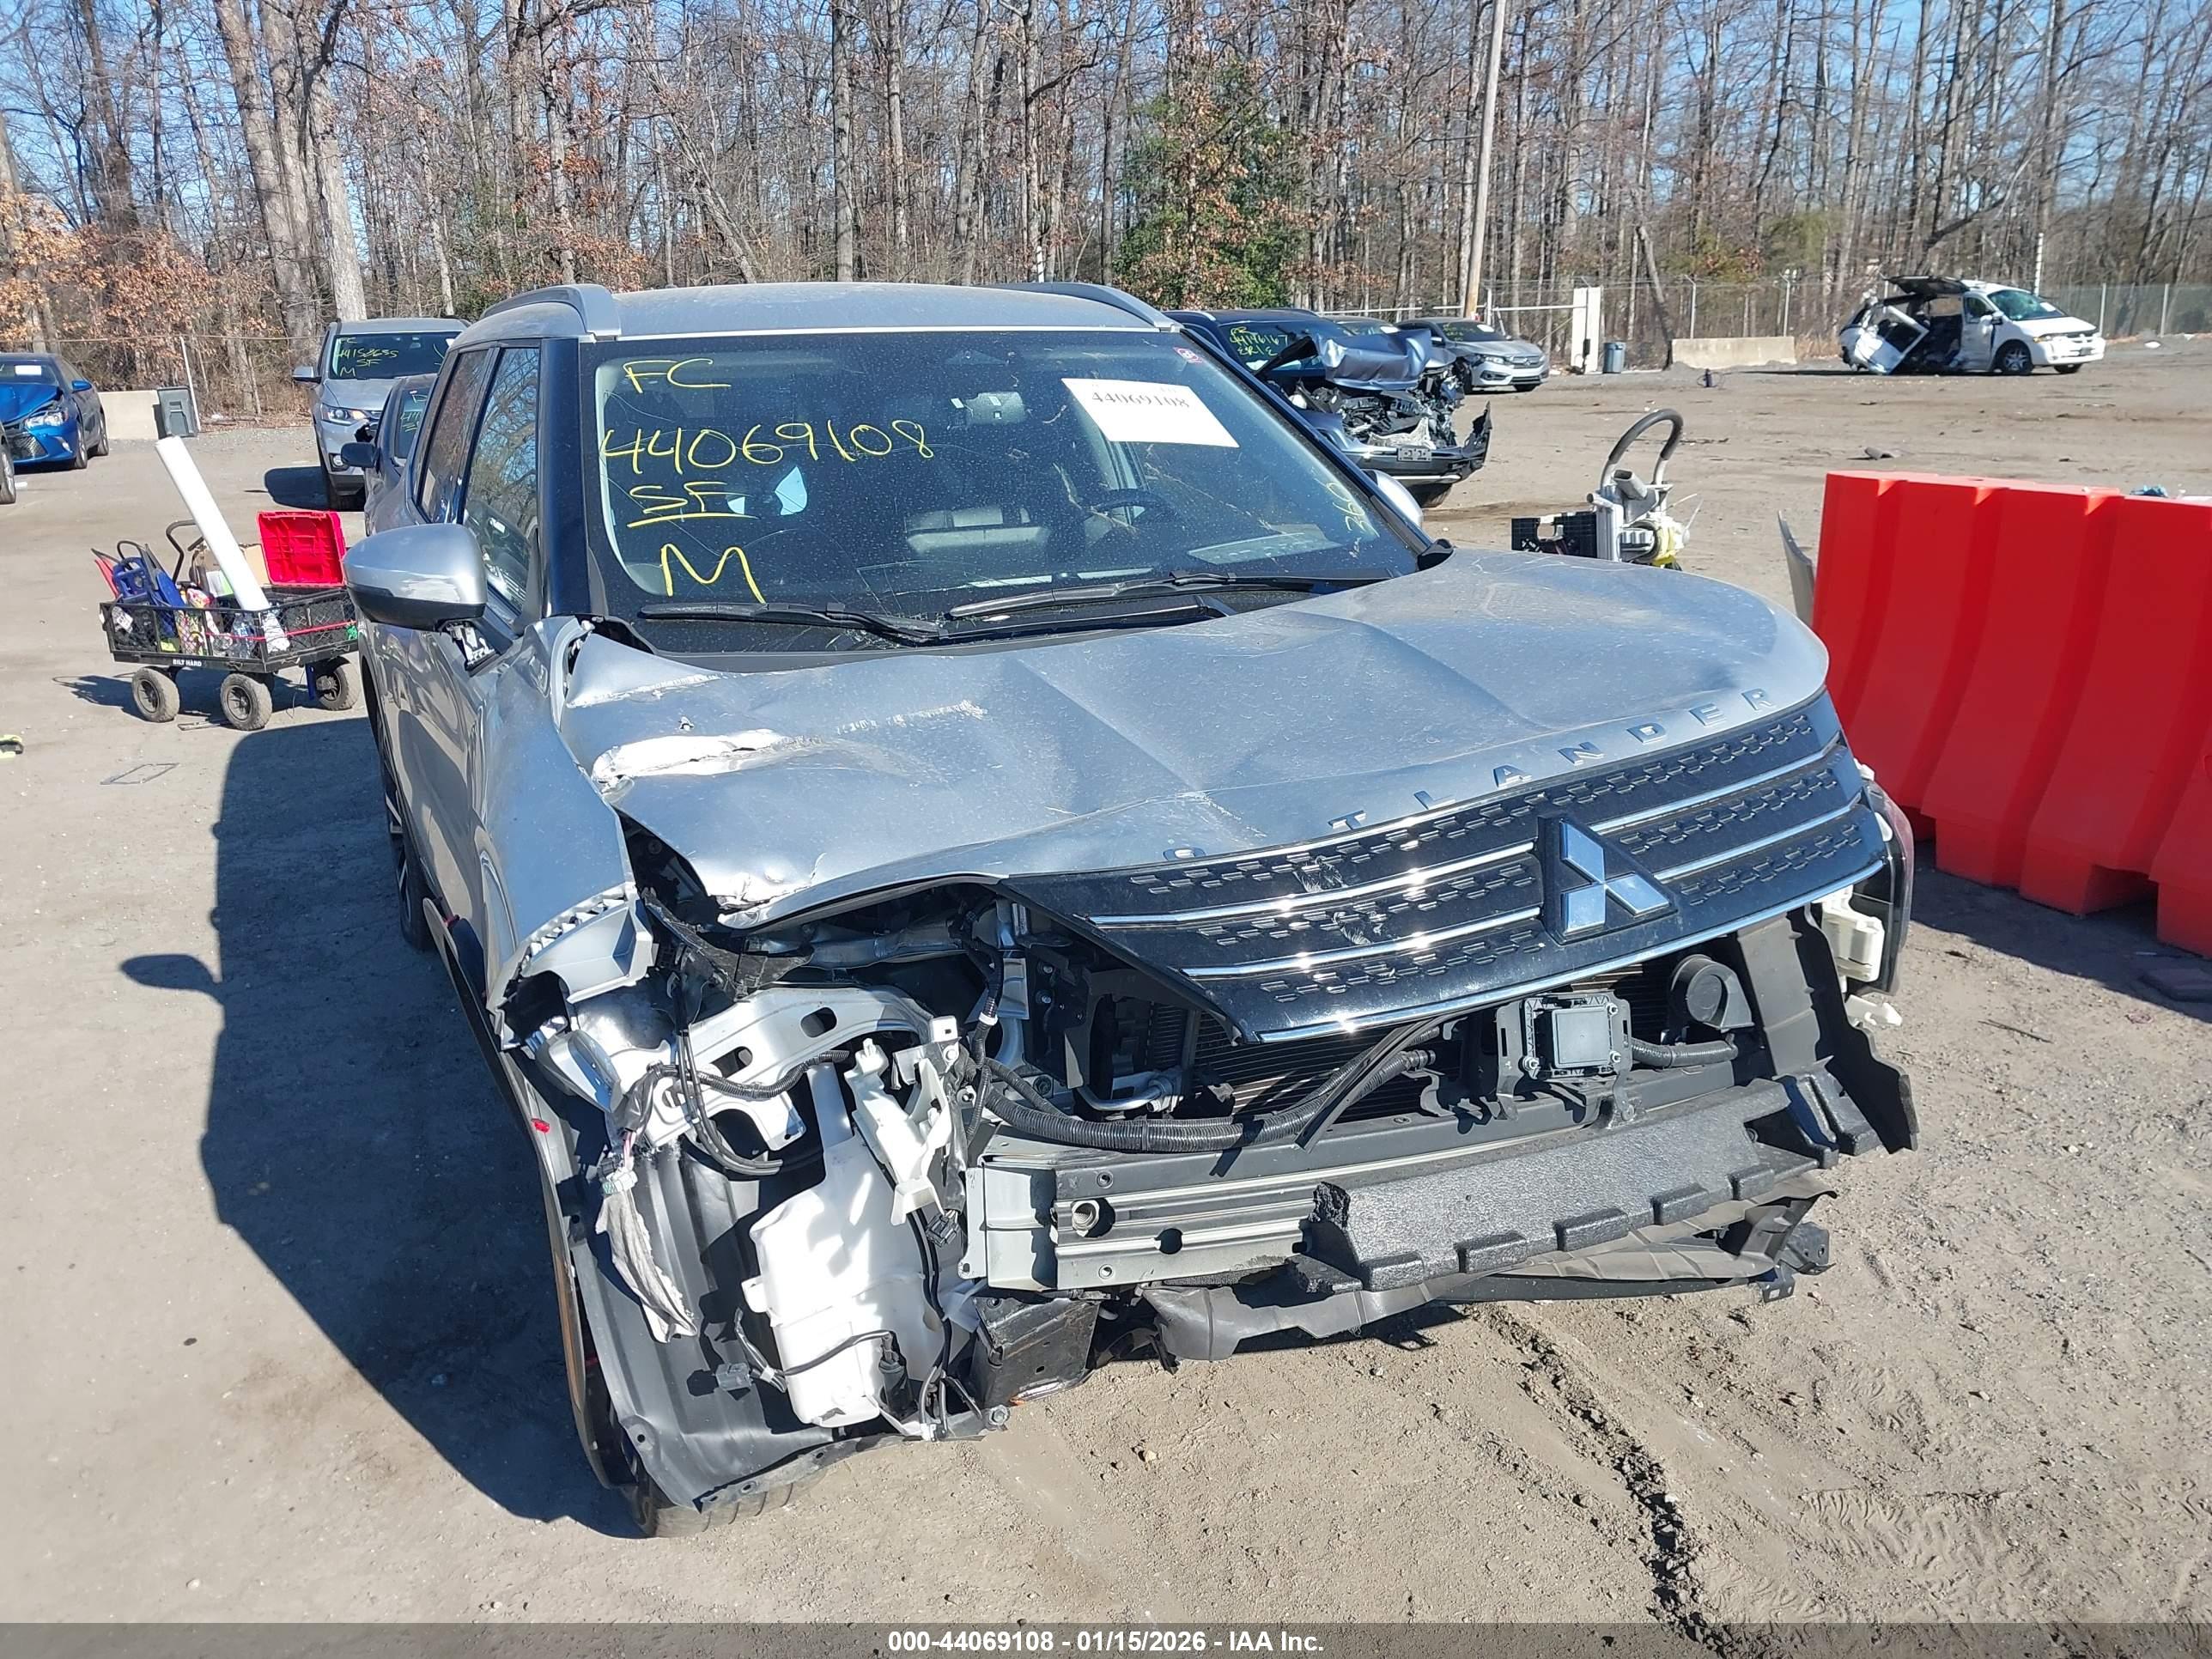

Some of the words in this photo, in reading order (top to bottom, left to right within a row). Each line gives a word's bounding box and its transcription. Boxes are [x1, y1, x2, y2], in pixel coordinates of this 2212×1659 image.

[339, 367, 356, 377] M
[623, 358, 732, 393] FC
[1091, 392, 1190, 408] 44069108
[601, 420, 934, 475] 44069108
[660, 543, 767, 605] M
